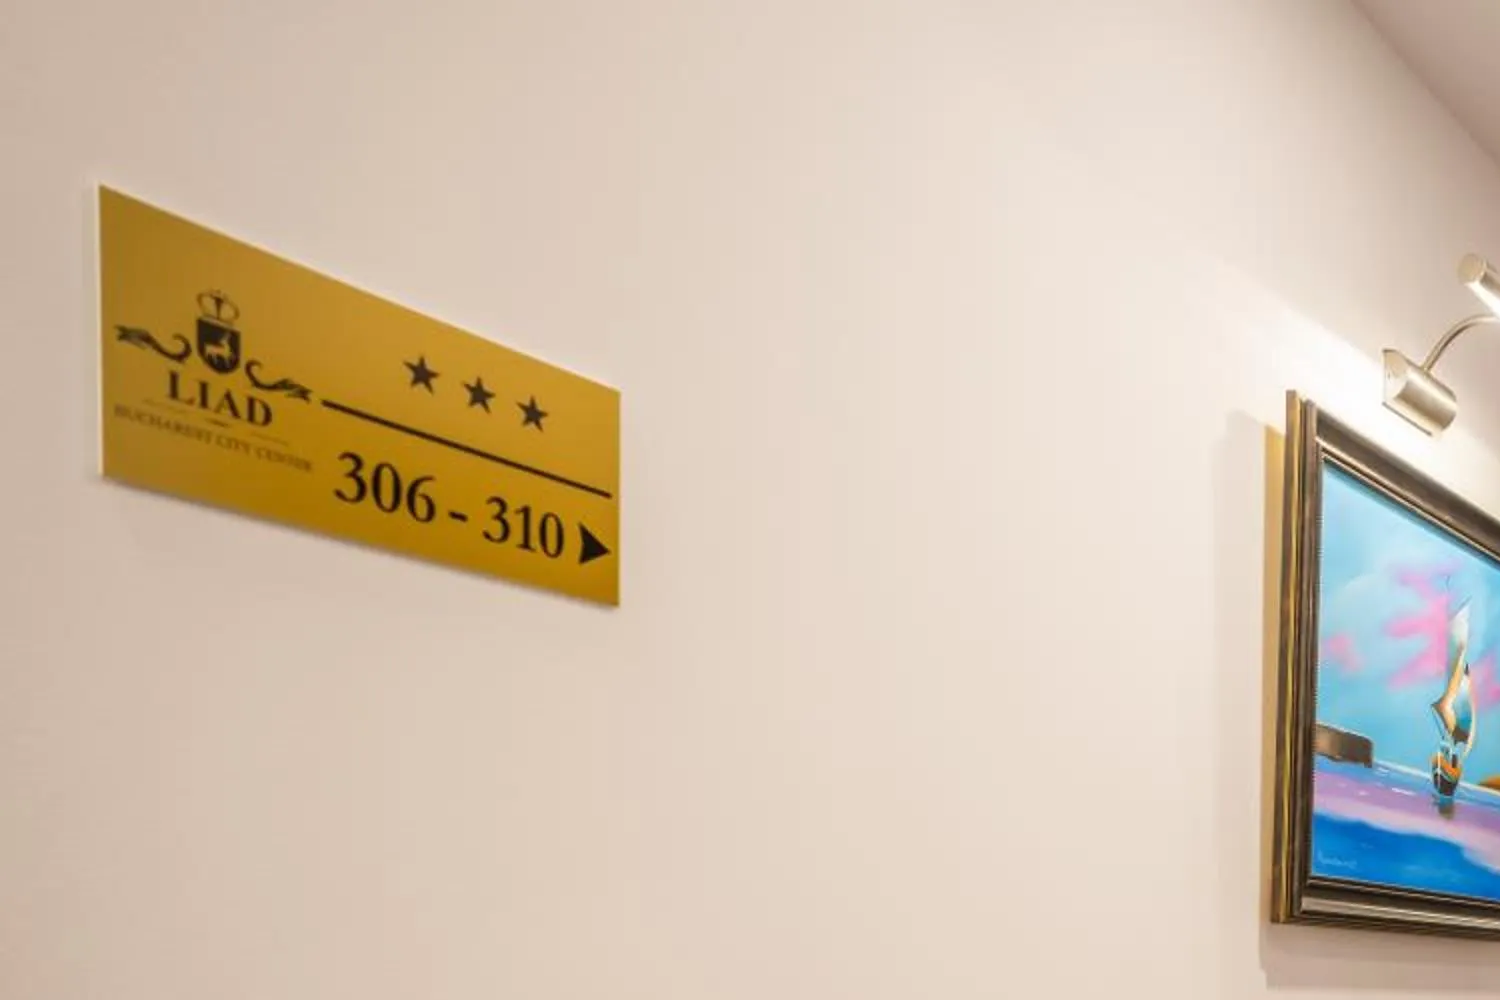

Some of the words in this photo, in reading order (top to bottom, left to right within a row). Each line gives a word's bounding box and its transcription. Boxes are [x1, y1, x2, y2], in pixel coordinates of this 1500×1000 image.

[169, 370, 273, 428] LIAD
[114, 403, 212, 445] BUCHAREST
[216, 434, 252, 461] CITY
[256, 446, 313, 473] CENTER
[333, 451, 436, 524] 306
[481, 496, 565, 560] 310
